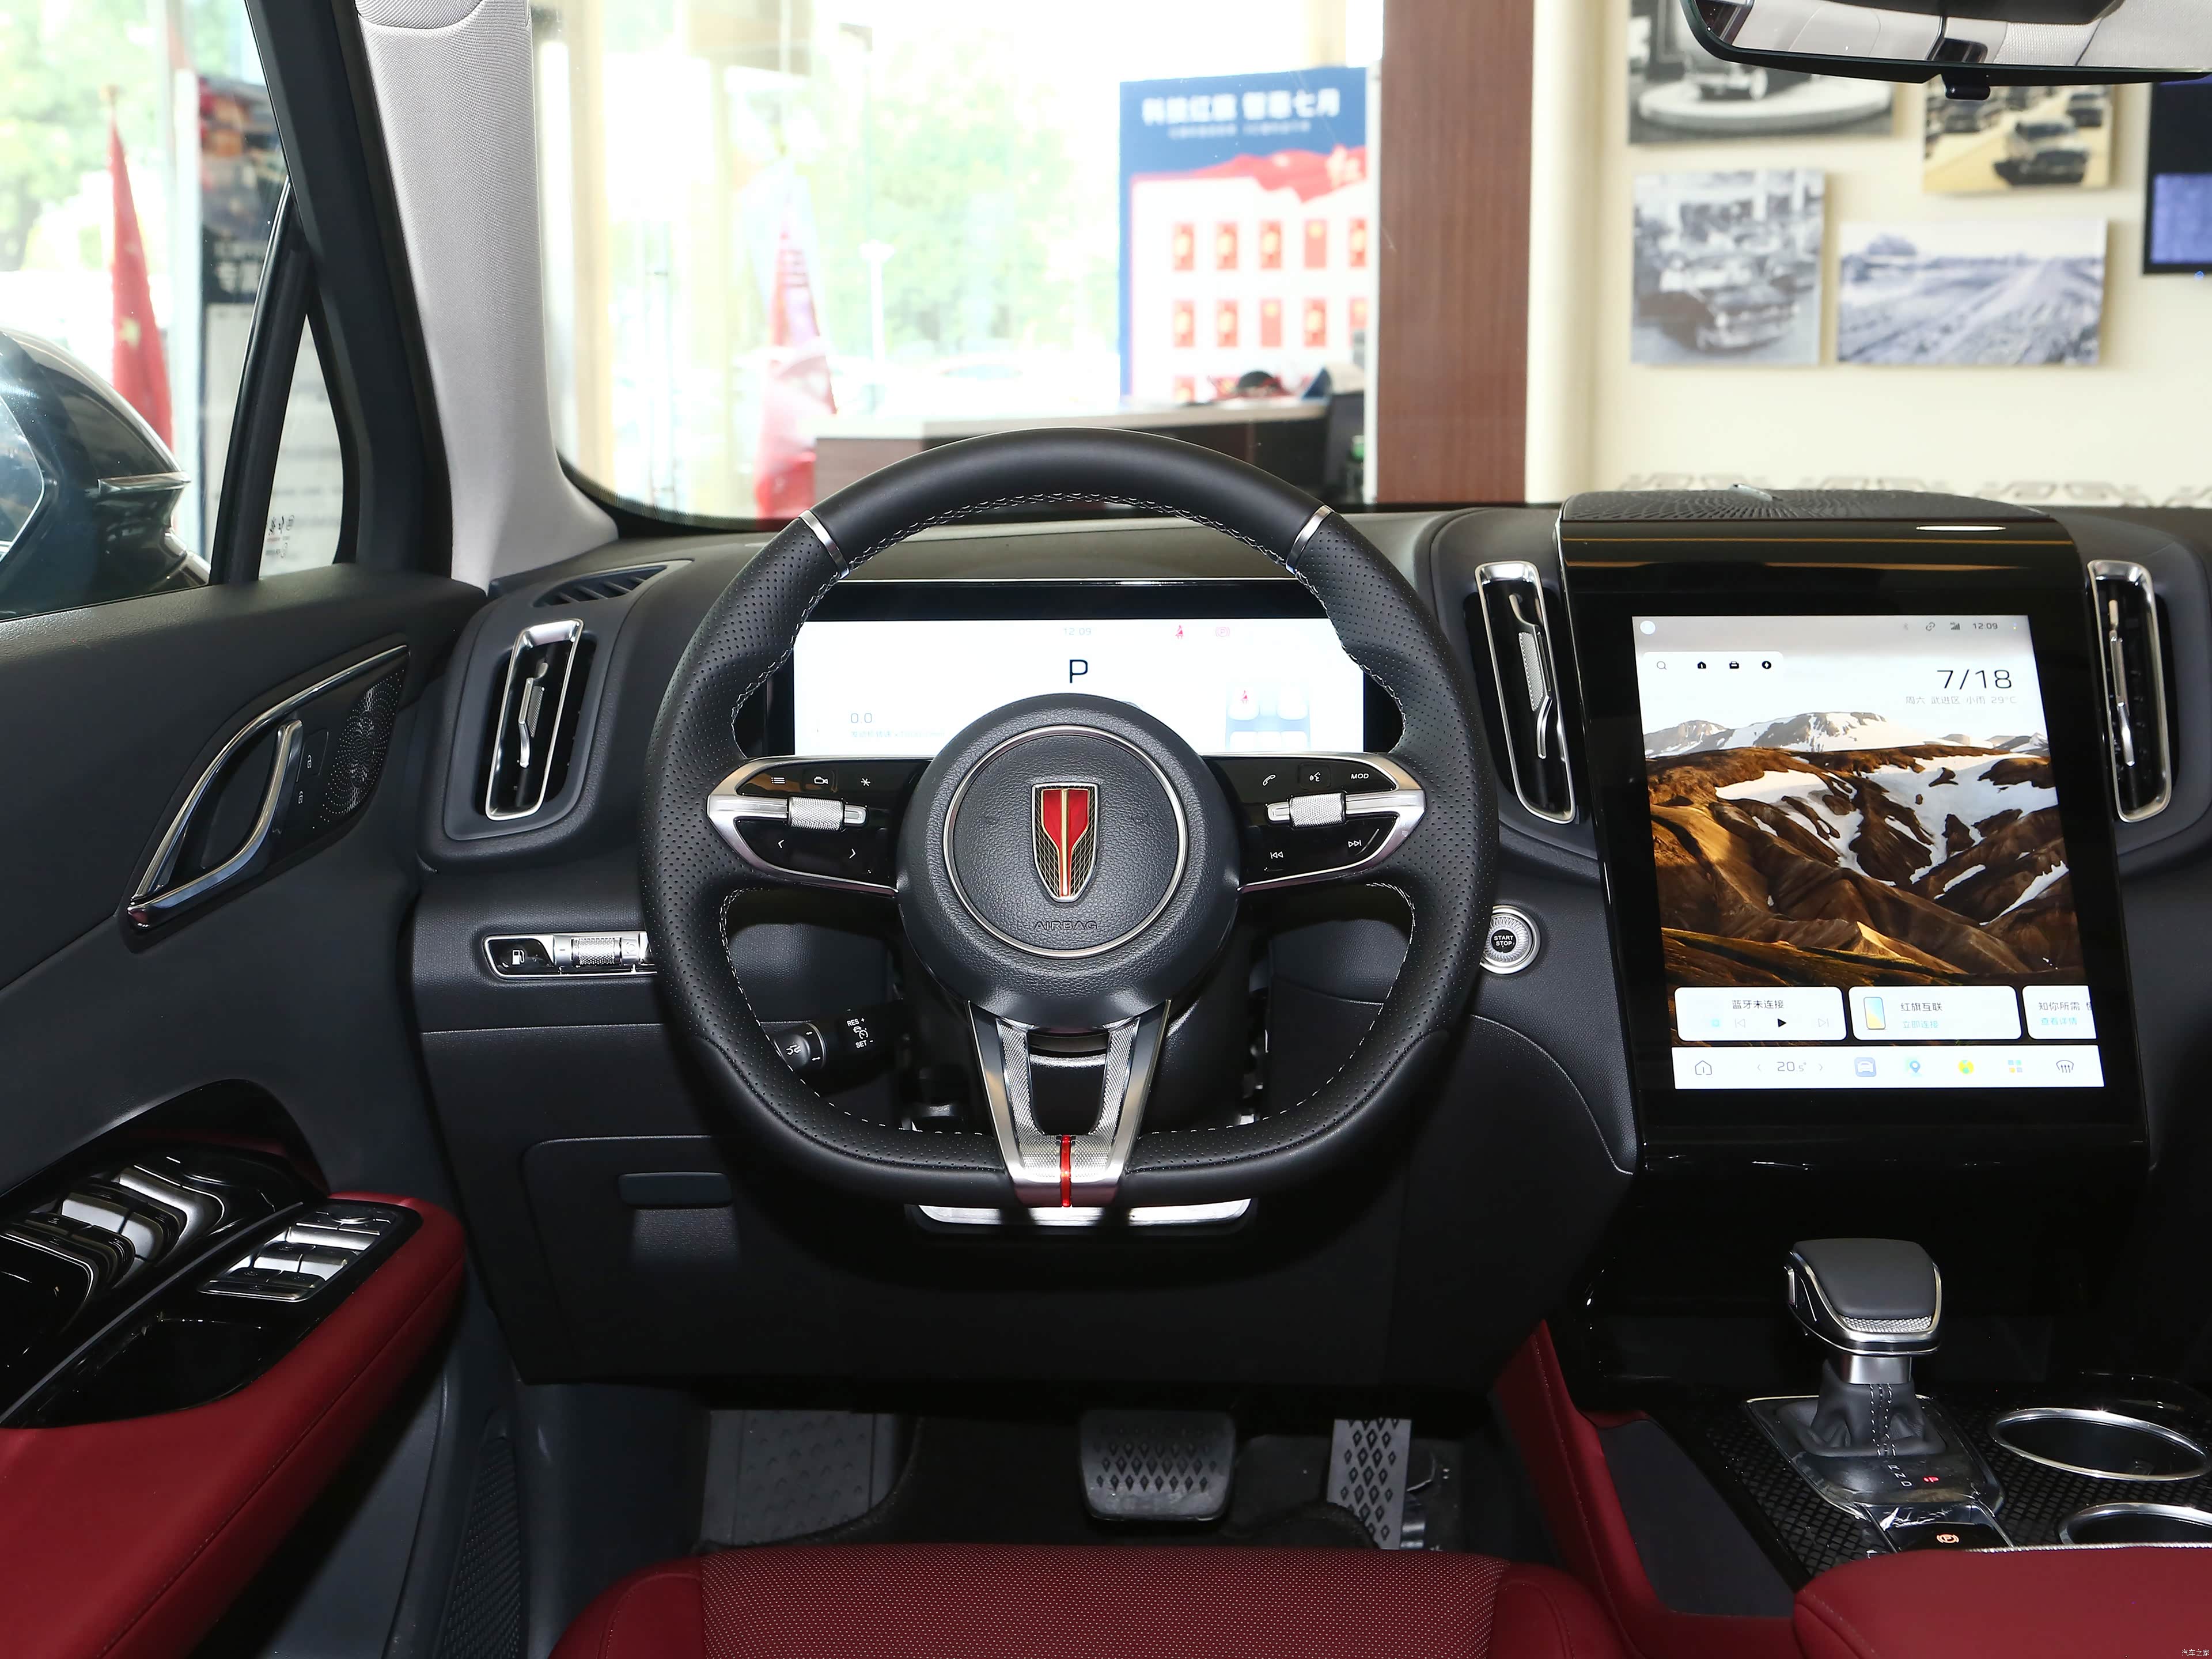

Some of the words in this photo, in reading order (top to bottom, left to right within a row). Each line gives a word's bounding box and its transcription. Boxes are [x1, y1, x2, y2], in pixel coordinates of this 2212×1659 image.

[1069, 659, 1088, 684] P
[1937, 669, 2012, 690] 7/18
[1906, 696, 1926, 704] 周六
[1931, 696, 1960, 704] 武进区
[1033, 921, 1098, 930] AIRBAG
[1732, 999, 1785, 1009] 蓝牙未连接
[1900, 1002, 1943, 1012] 红旗互联
[2038, 1002, 2081, 1011] 知你所需
[847, 1018, 859, 1027] RES
